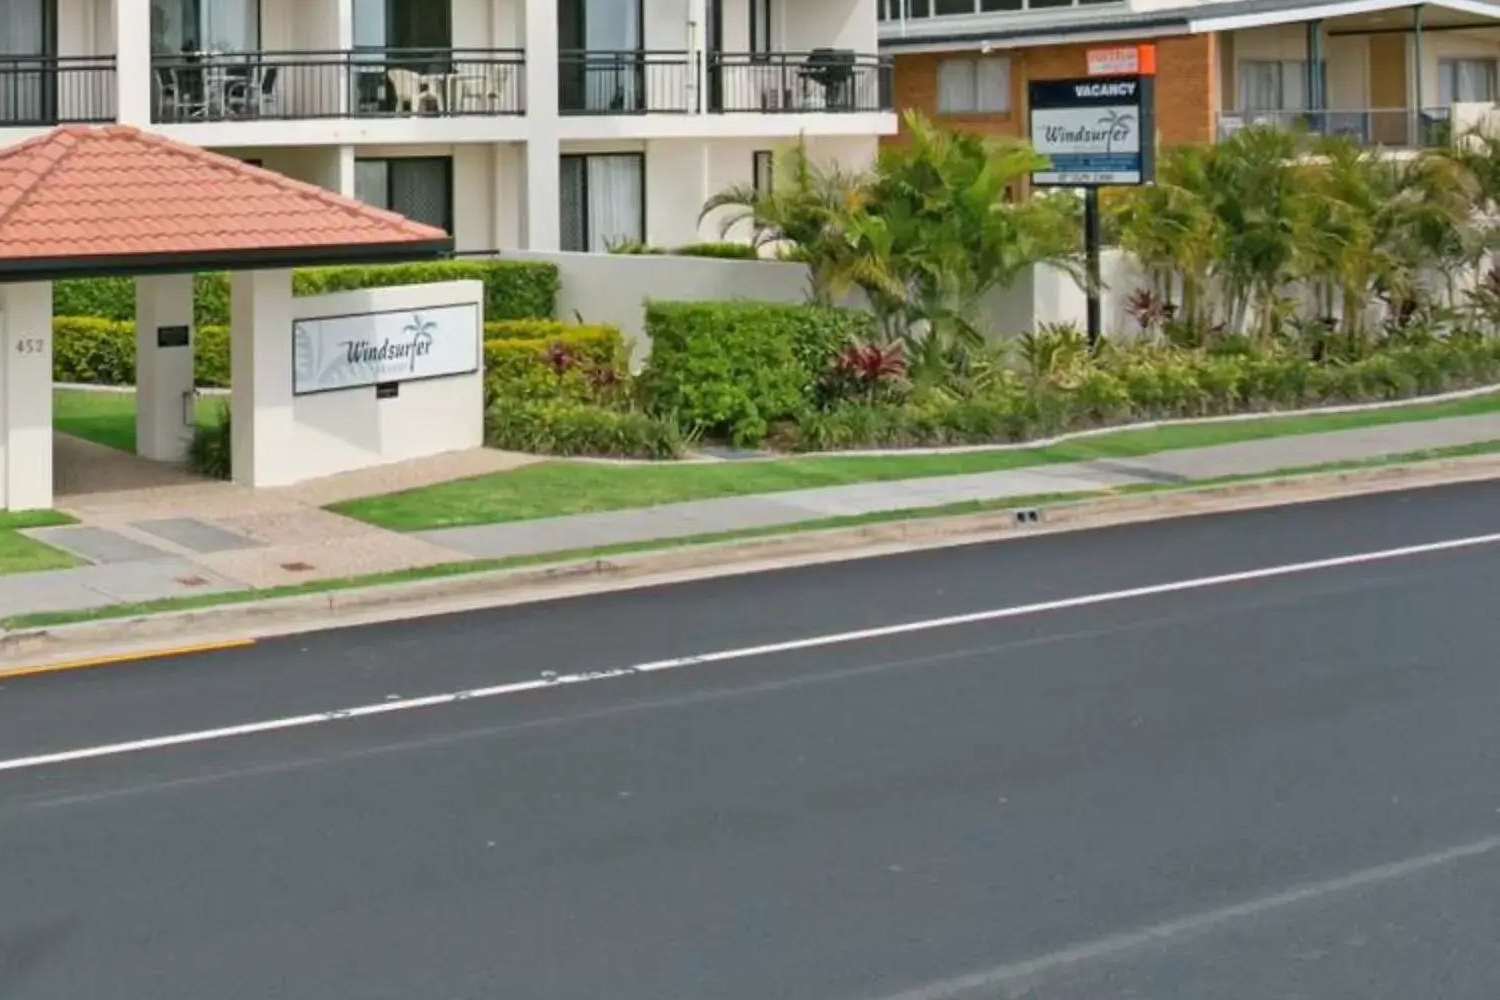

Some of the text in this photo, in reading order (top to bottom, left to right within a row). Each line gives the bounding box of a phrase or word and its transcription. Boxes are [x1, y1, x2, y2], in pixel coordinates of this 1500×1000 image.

[1075, 83, 1136, 97] VACANCY
[1044, 124, 1129, 149] Windsurfer
[338, 336, 432, 371] Windsurfer
